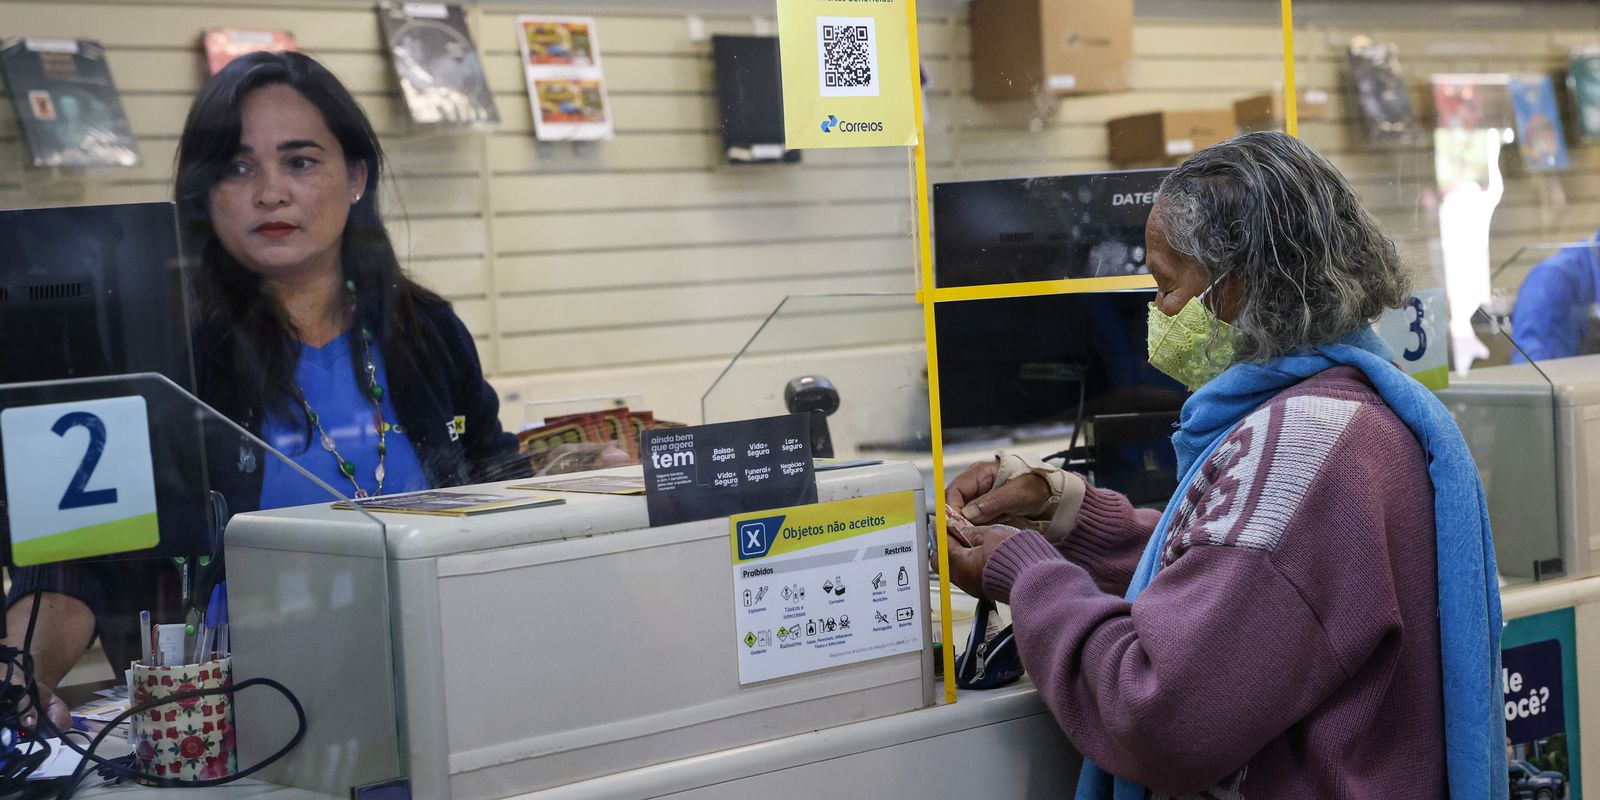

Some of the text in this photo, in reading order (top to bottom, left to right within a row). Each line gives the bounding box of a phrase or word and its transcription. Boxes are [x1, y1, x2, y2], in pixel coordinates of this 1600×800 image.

[839, 120, 884, 133] Correios
[1403, 296, 1427, 362] 3
[651, 434, 694, 444] ainda bem
[651, 441, 694, 452] que agora
[781, 443, 803, 452] Seguro
[712, 453, 736, 462] Segura
[747, 448, 770, 458] Segura
[51, 411, 118, 510] 2
[651, 451, 695, 469] tem
[782, 467, 804, 476] Seguro
[714, 477, 739, 487] Segura
[747, 473, 769, 483] Seguro
[782, 515, 886, 541] Objetos não aceitos
[746, 529, 762, 549] X
[884, 544, 912, 556] Restritos
[742, 566, 774, 578] Proibidos
[1504, 686, 1550, 721] ocê?
